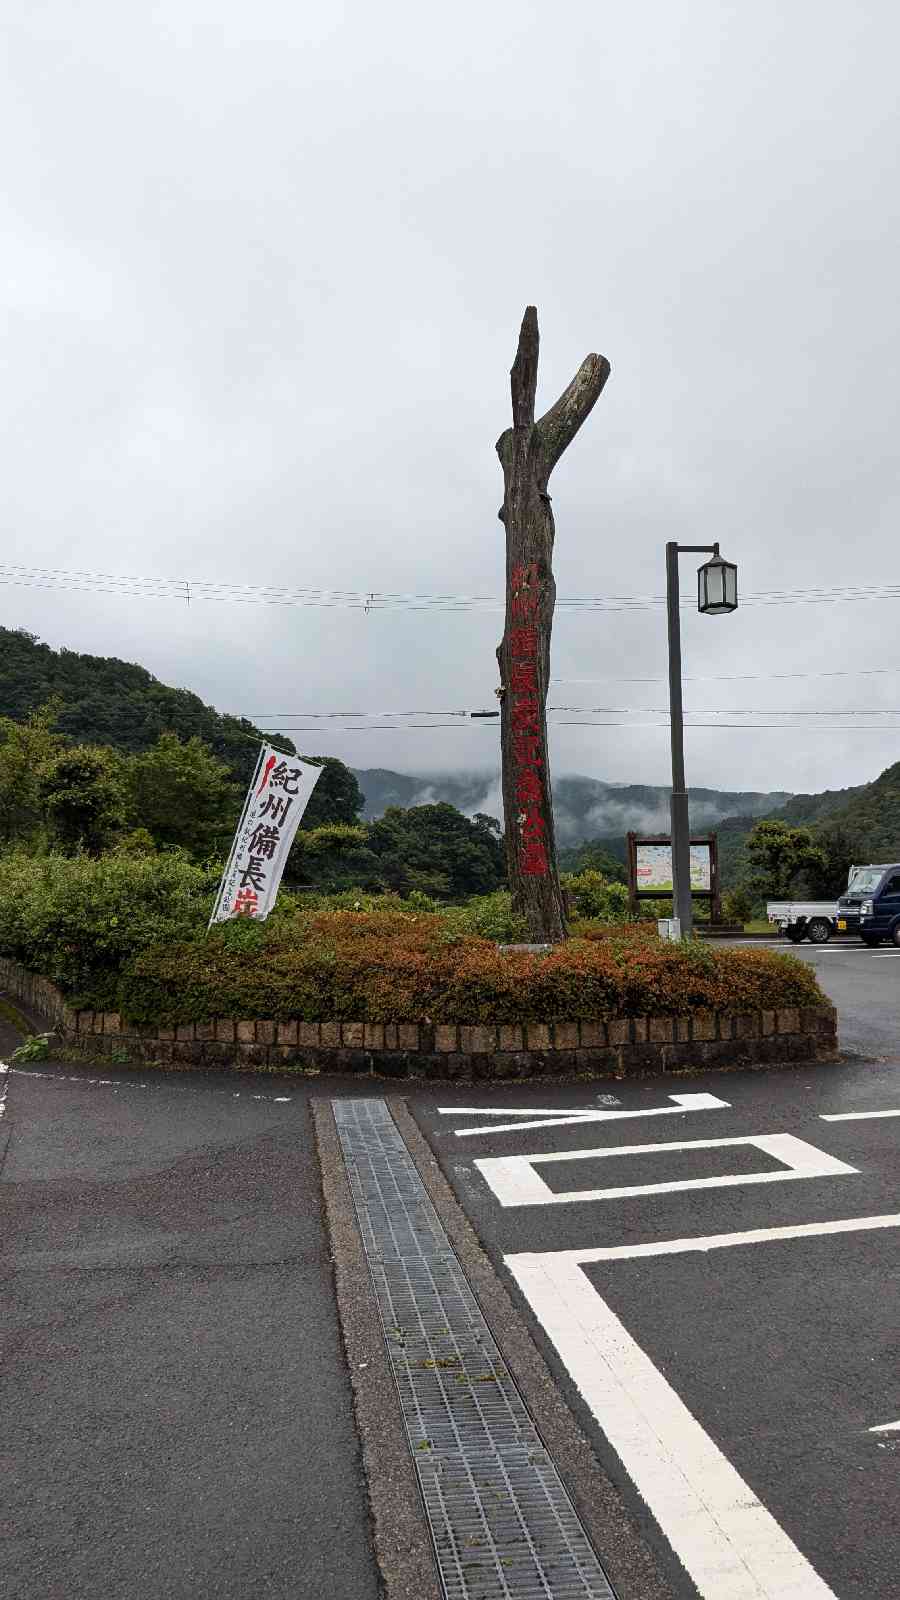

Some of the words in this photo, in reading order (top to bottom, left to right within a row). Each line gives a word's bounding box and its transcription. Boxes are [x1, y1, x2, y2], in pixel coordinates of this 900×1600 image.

[232, 760, 303, 916] 紀州備長炭
